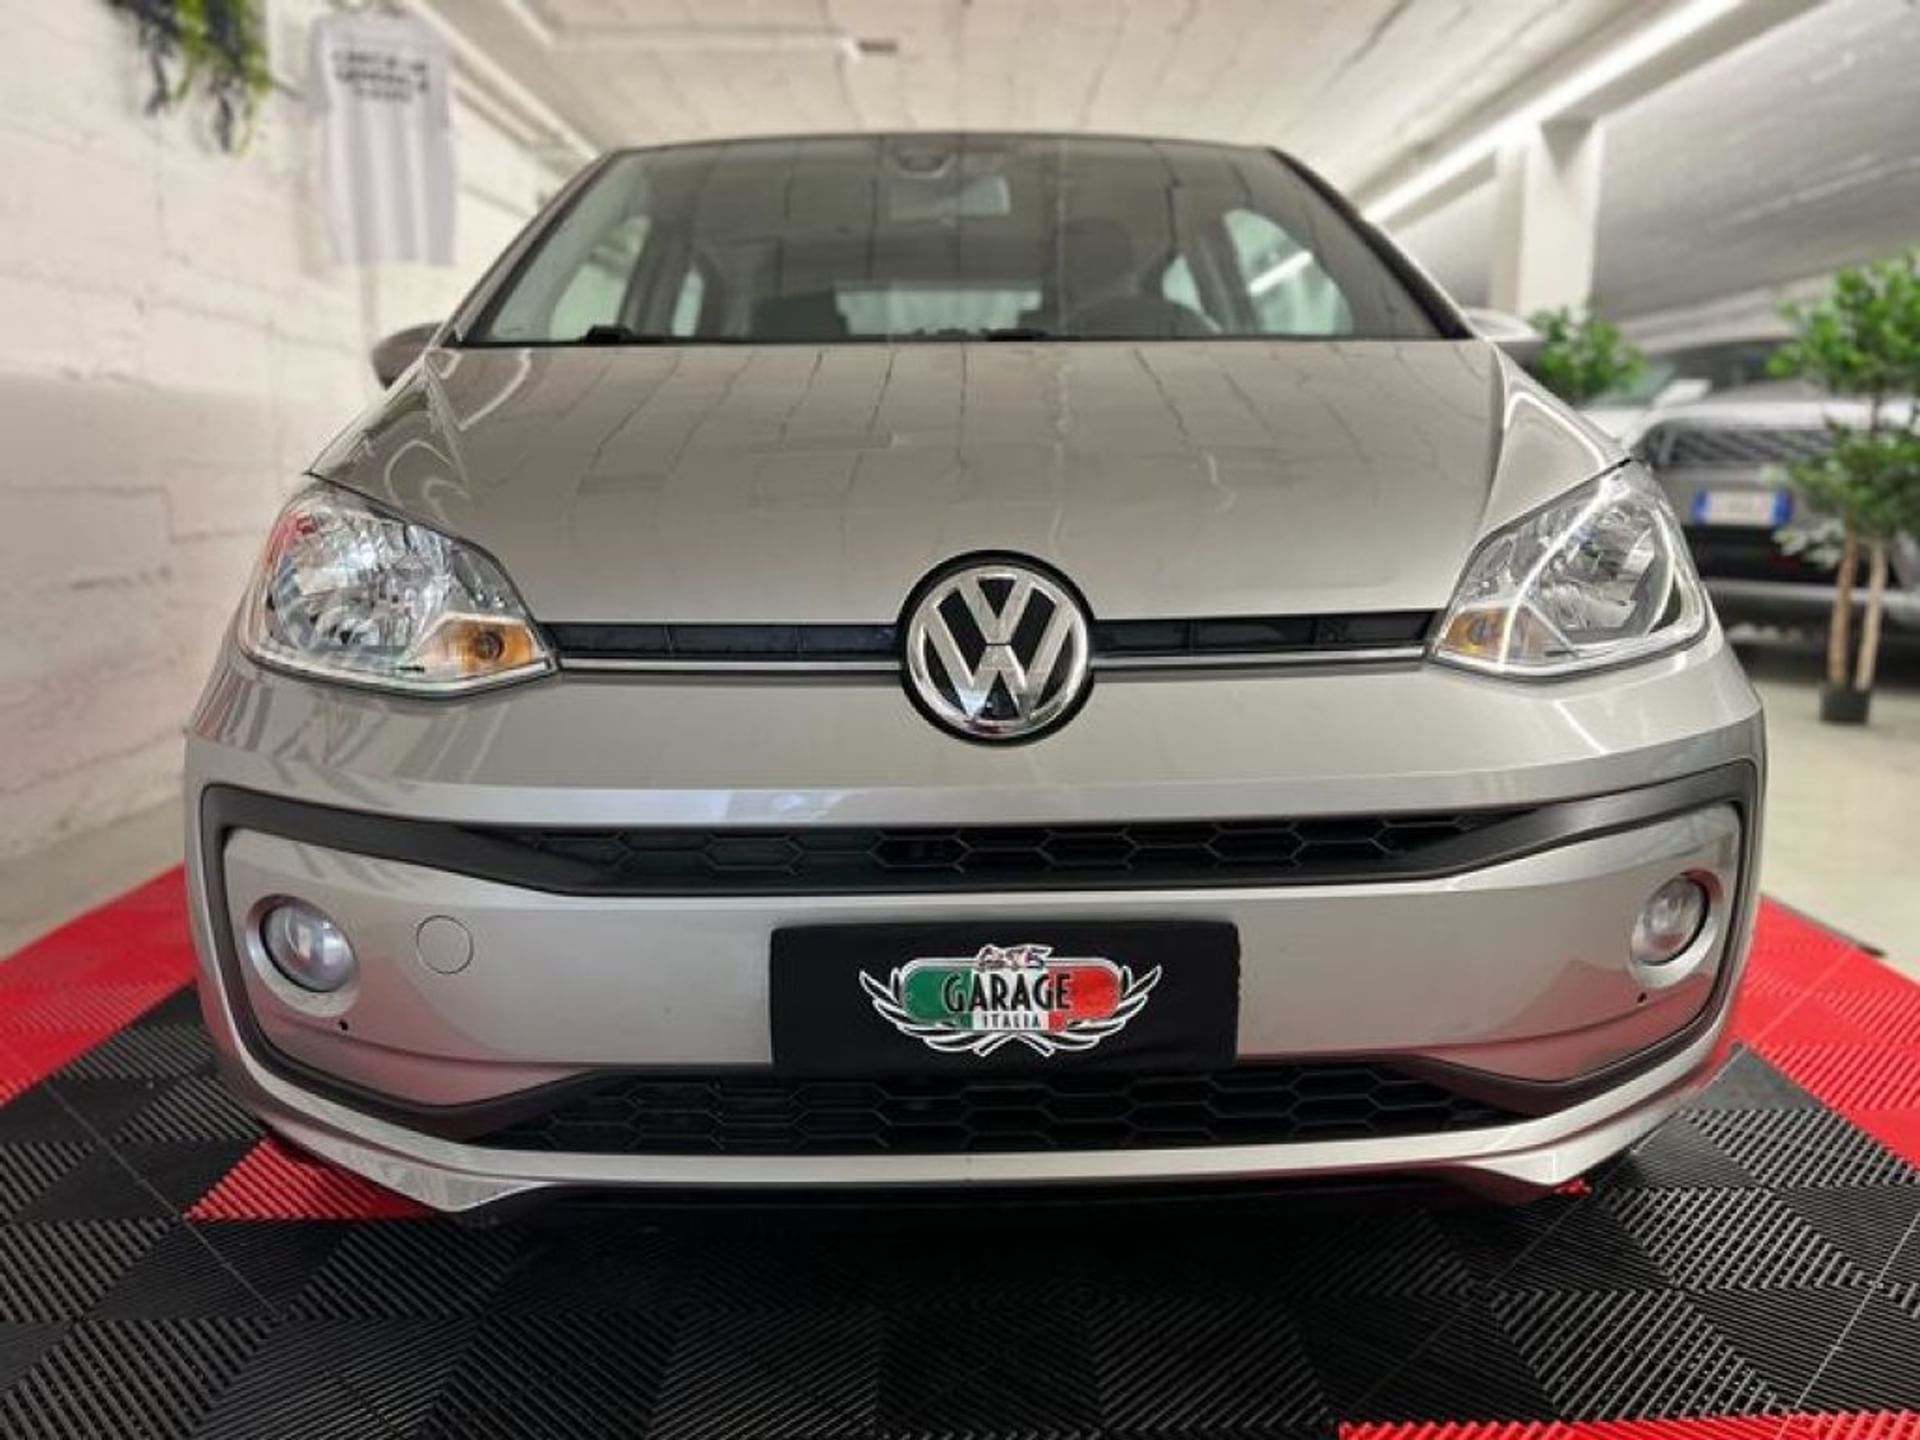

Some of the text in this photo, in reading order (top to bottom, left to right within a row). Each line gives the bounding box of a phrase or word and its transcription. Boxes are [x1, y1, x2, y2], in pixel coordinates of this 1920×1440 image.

[911, 567, 1083, 732] VW
[944, 973, 1071, 1012] GARAGE
[983, 1012, 1042, 1029] ITALIA
